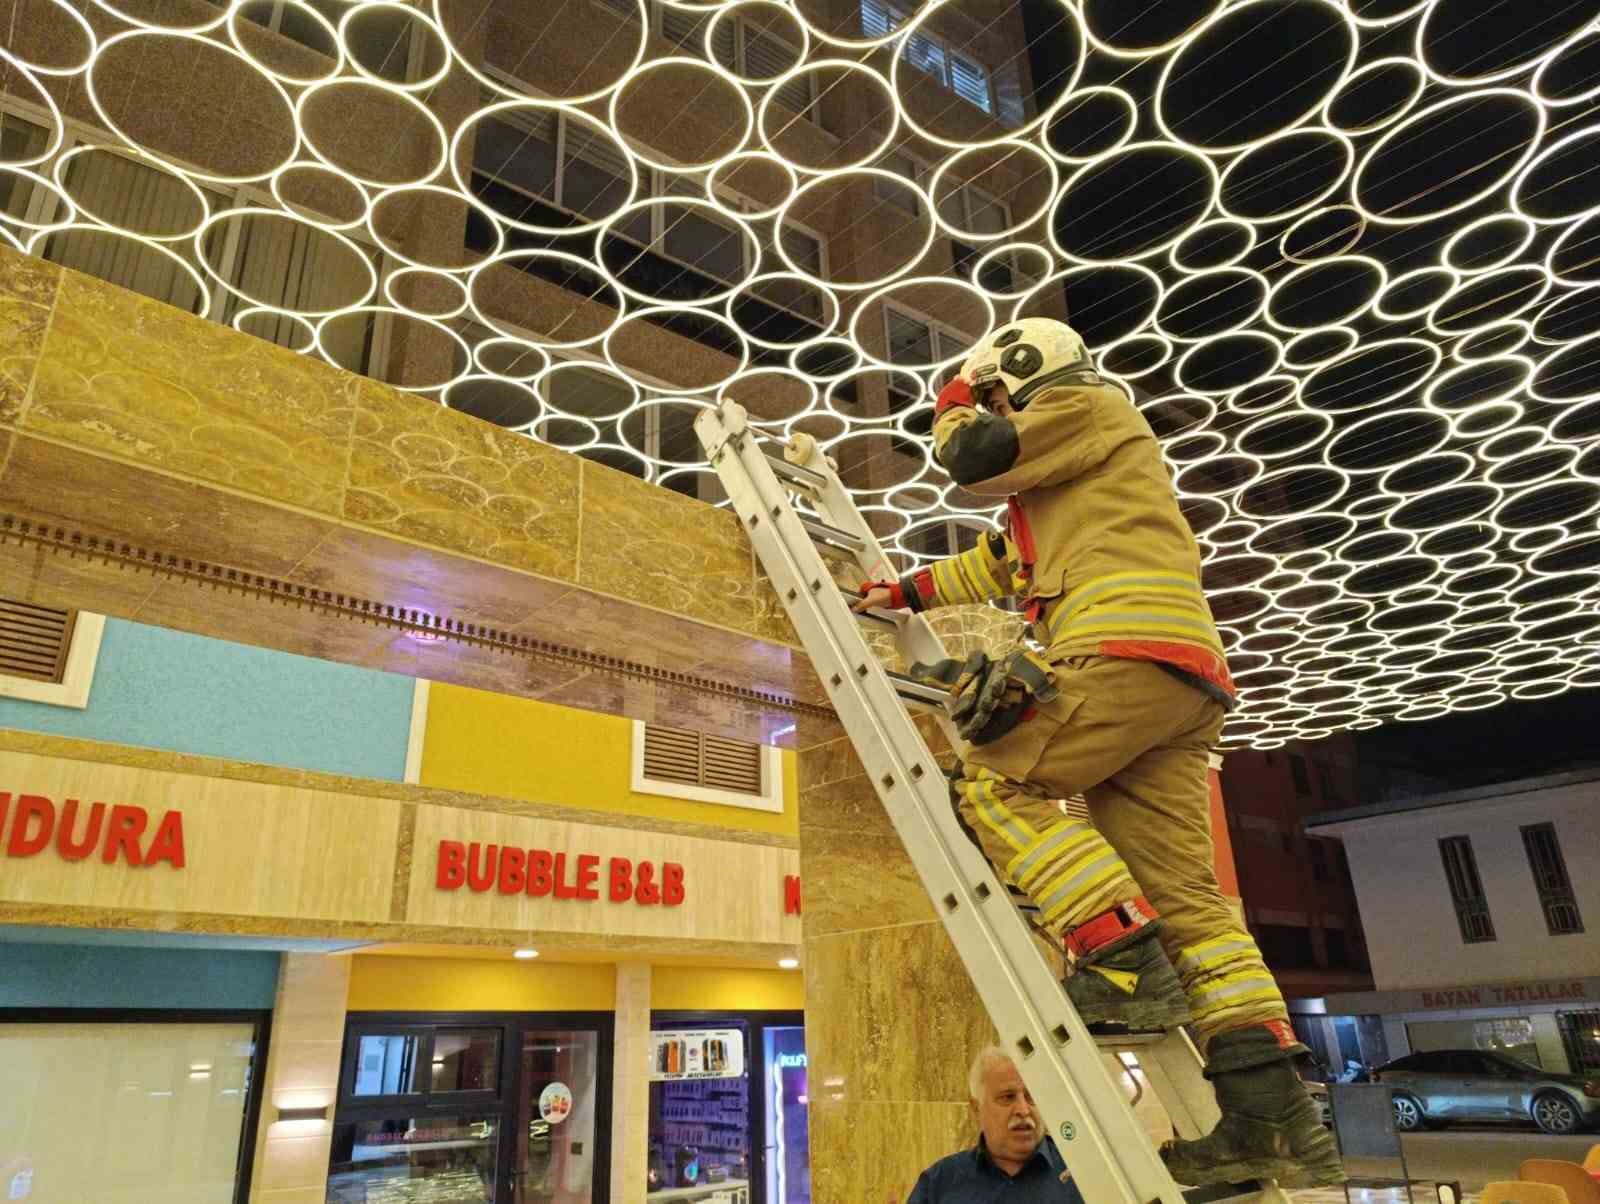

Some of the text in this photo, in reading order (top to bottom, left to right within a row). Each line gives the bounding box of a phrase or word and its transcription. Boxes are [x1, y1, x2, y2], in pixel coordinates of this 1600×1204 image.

[436, 840, 685, 906] BUBBLE B&B
[1422, 982, 1585, 1008] BAYAN TATLILAR
